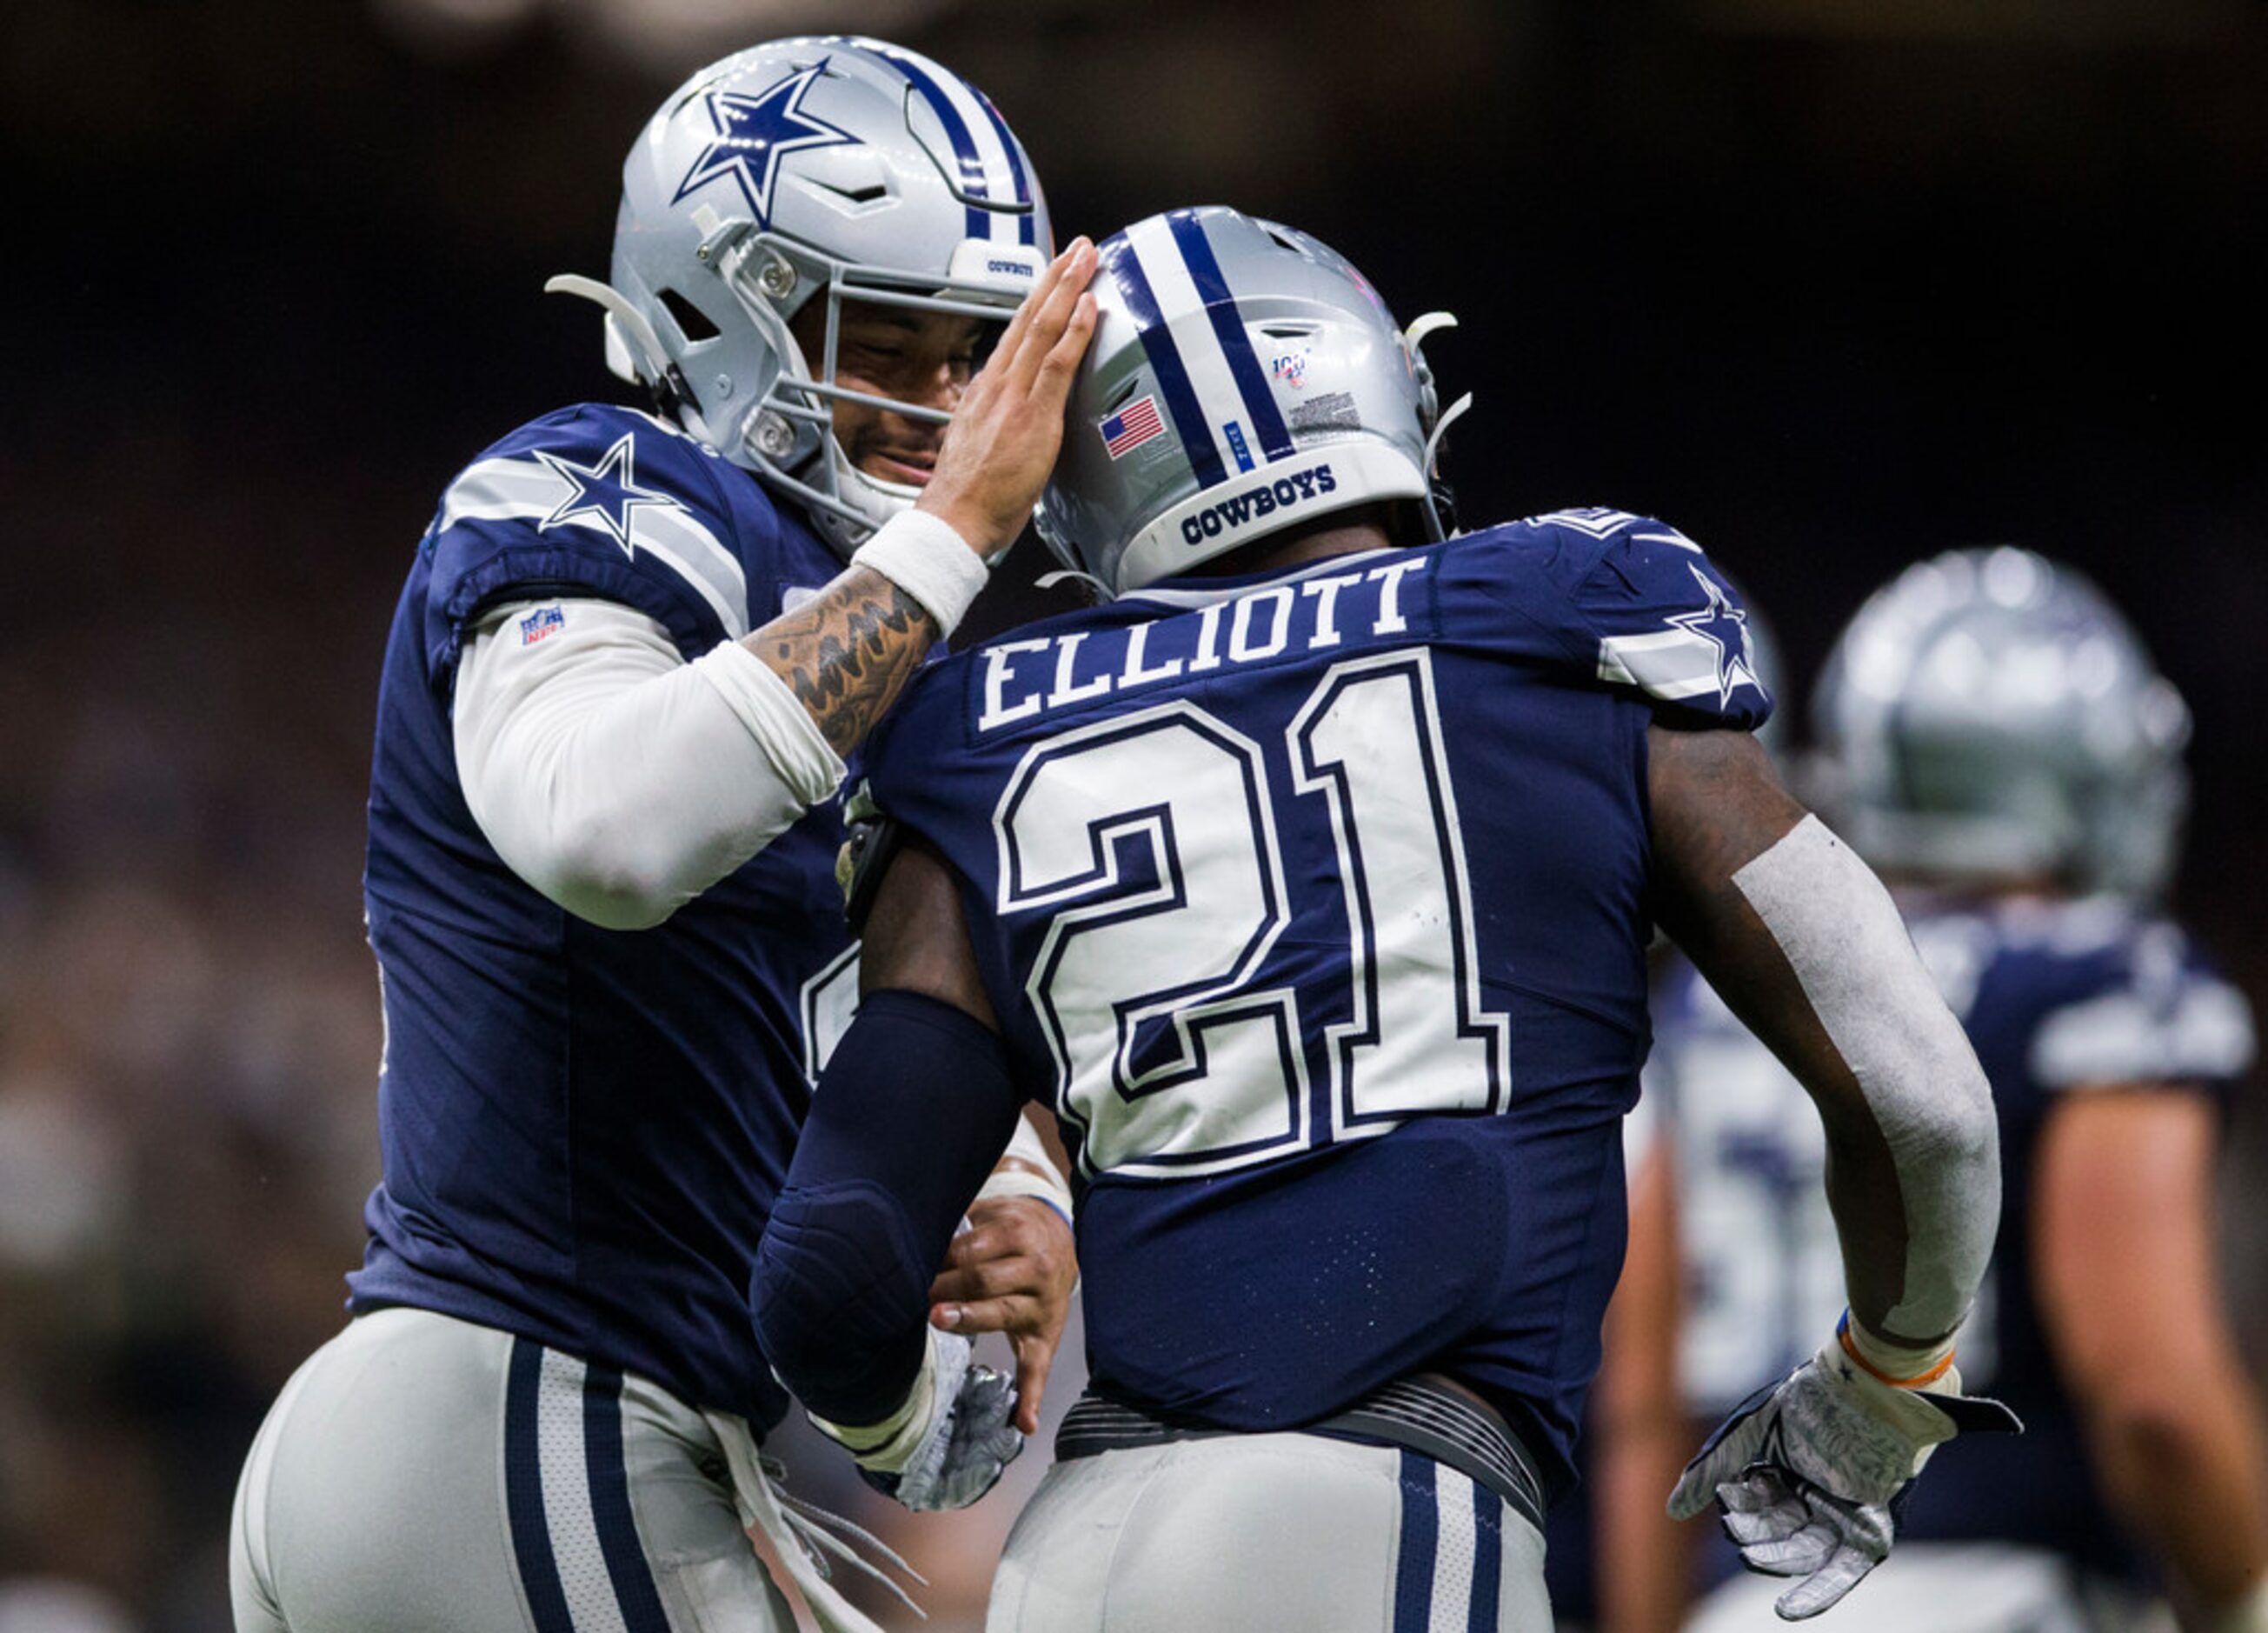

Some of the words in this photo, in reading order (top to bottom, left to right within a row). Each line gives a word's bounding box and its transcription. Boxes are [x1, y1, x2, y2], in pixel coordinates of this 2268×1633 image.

[1181, 463, 1336, 545] COWBOYS
[979, 556, 1427, 733] ELLIOTT
[991, 646, 1511, 1180] 21
